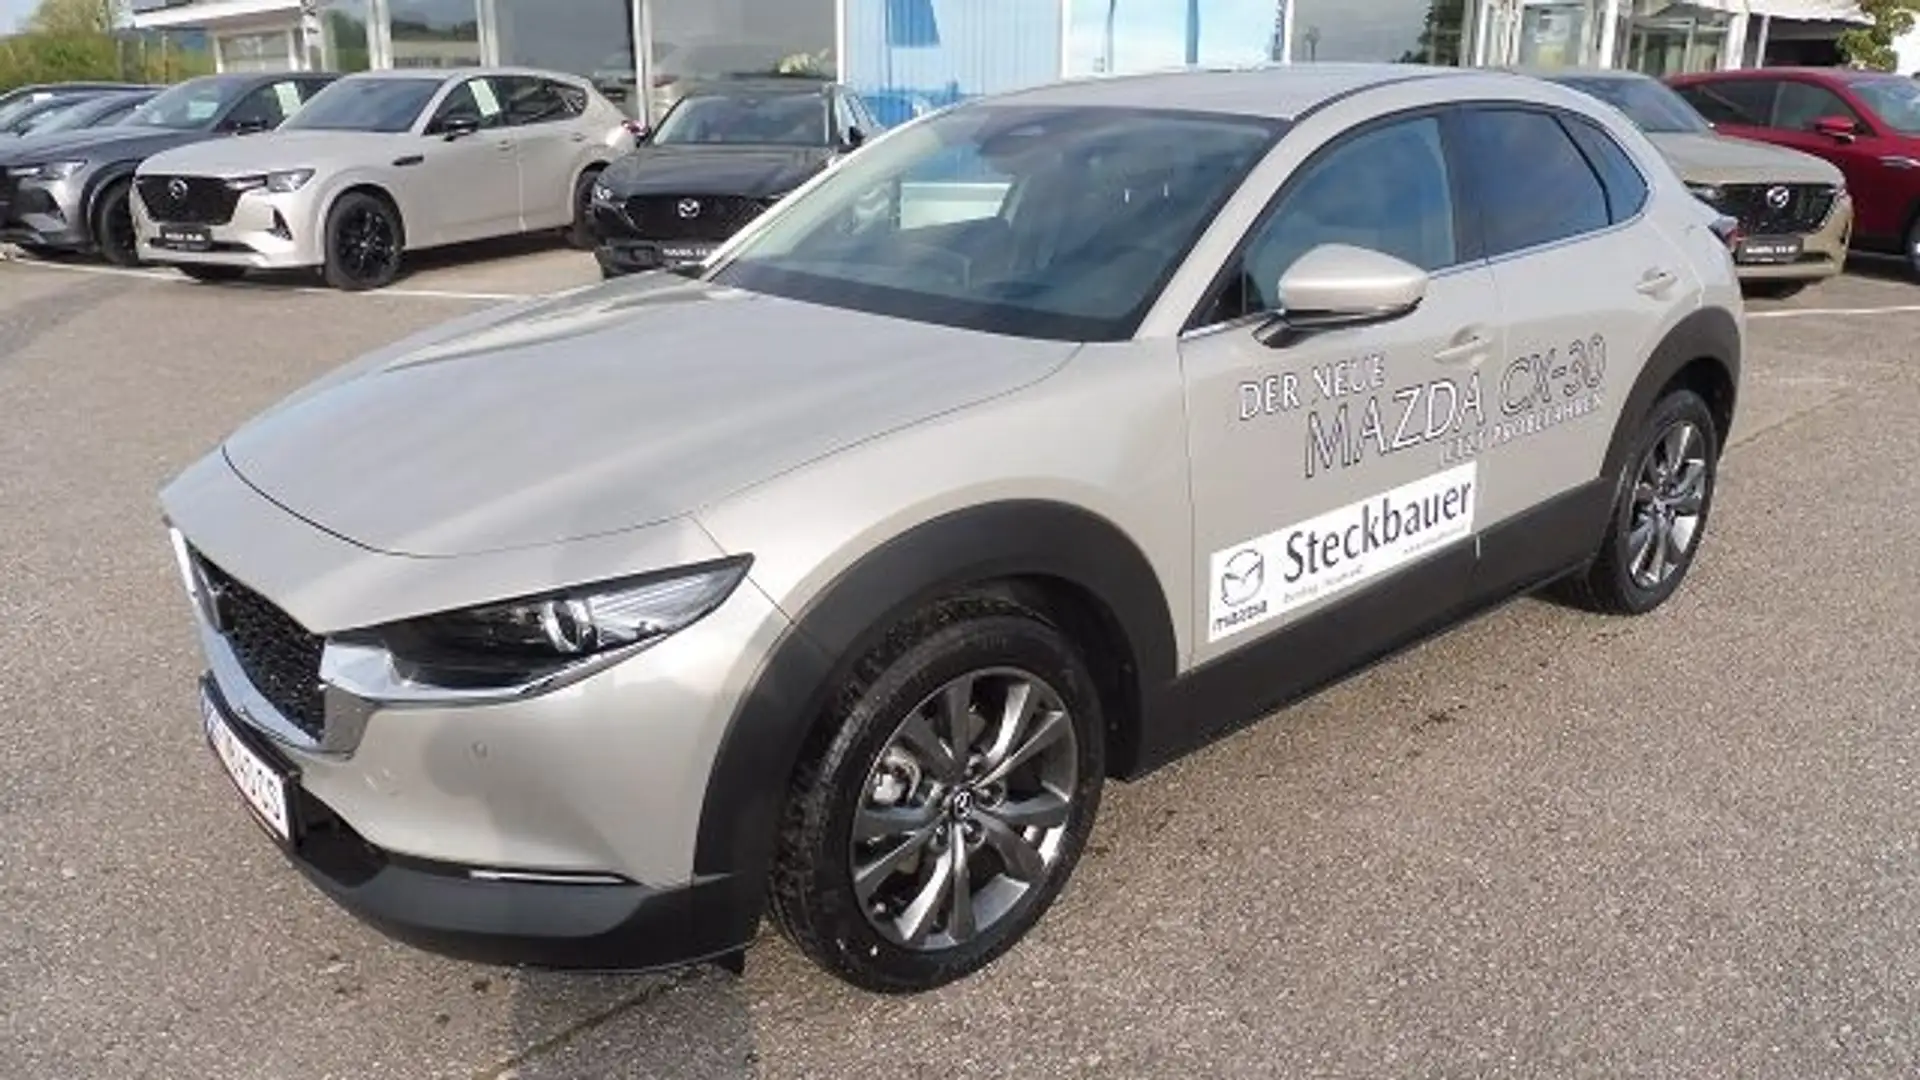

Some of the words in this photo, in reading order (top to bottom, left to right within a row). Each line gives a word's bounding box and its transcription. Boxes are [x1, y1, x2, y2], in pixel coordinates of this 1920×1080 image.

[1239, 372, 1301, 421] DER
[1312, 353, 1385, 405] NEUE
[1305, 373, 1486, 479] MAZDA
[1500, 332, 1606, 416] CX-30
[1284, 482, 1472, 583] Steckbauer
